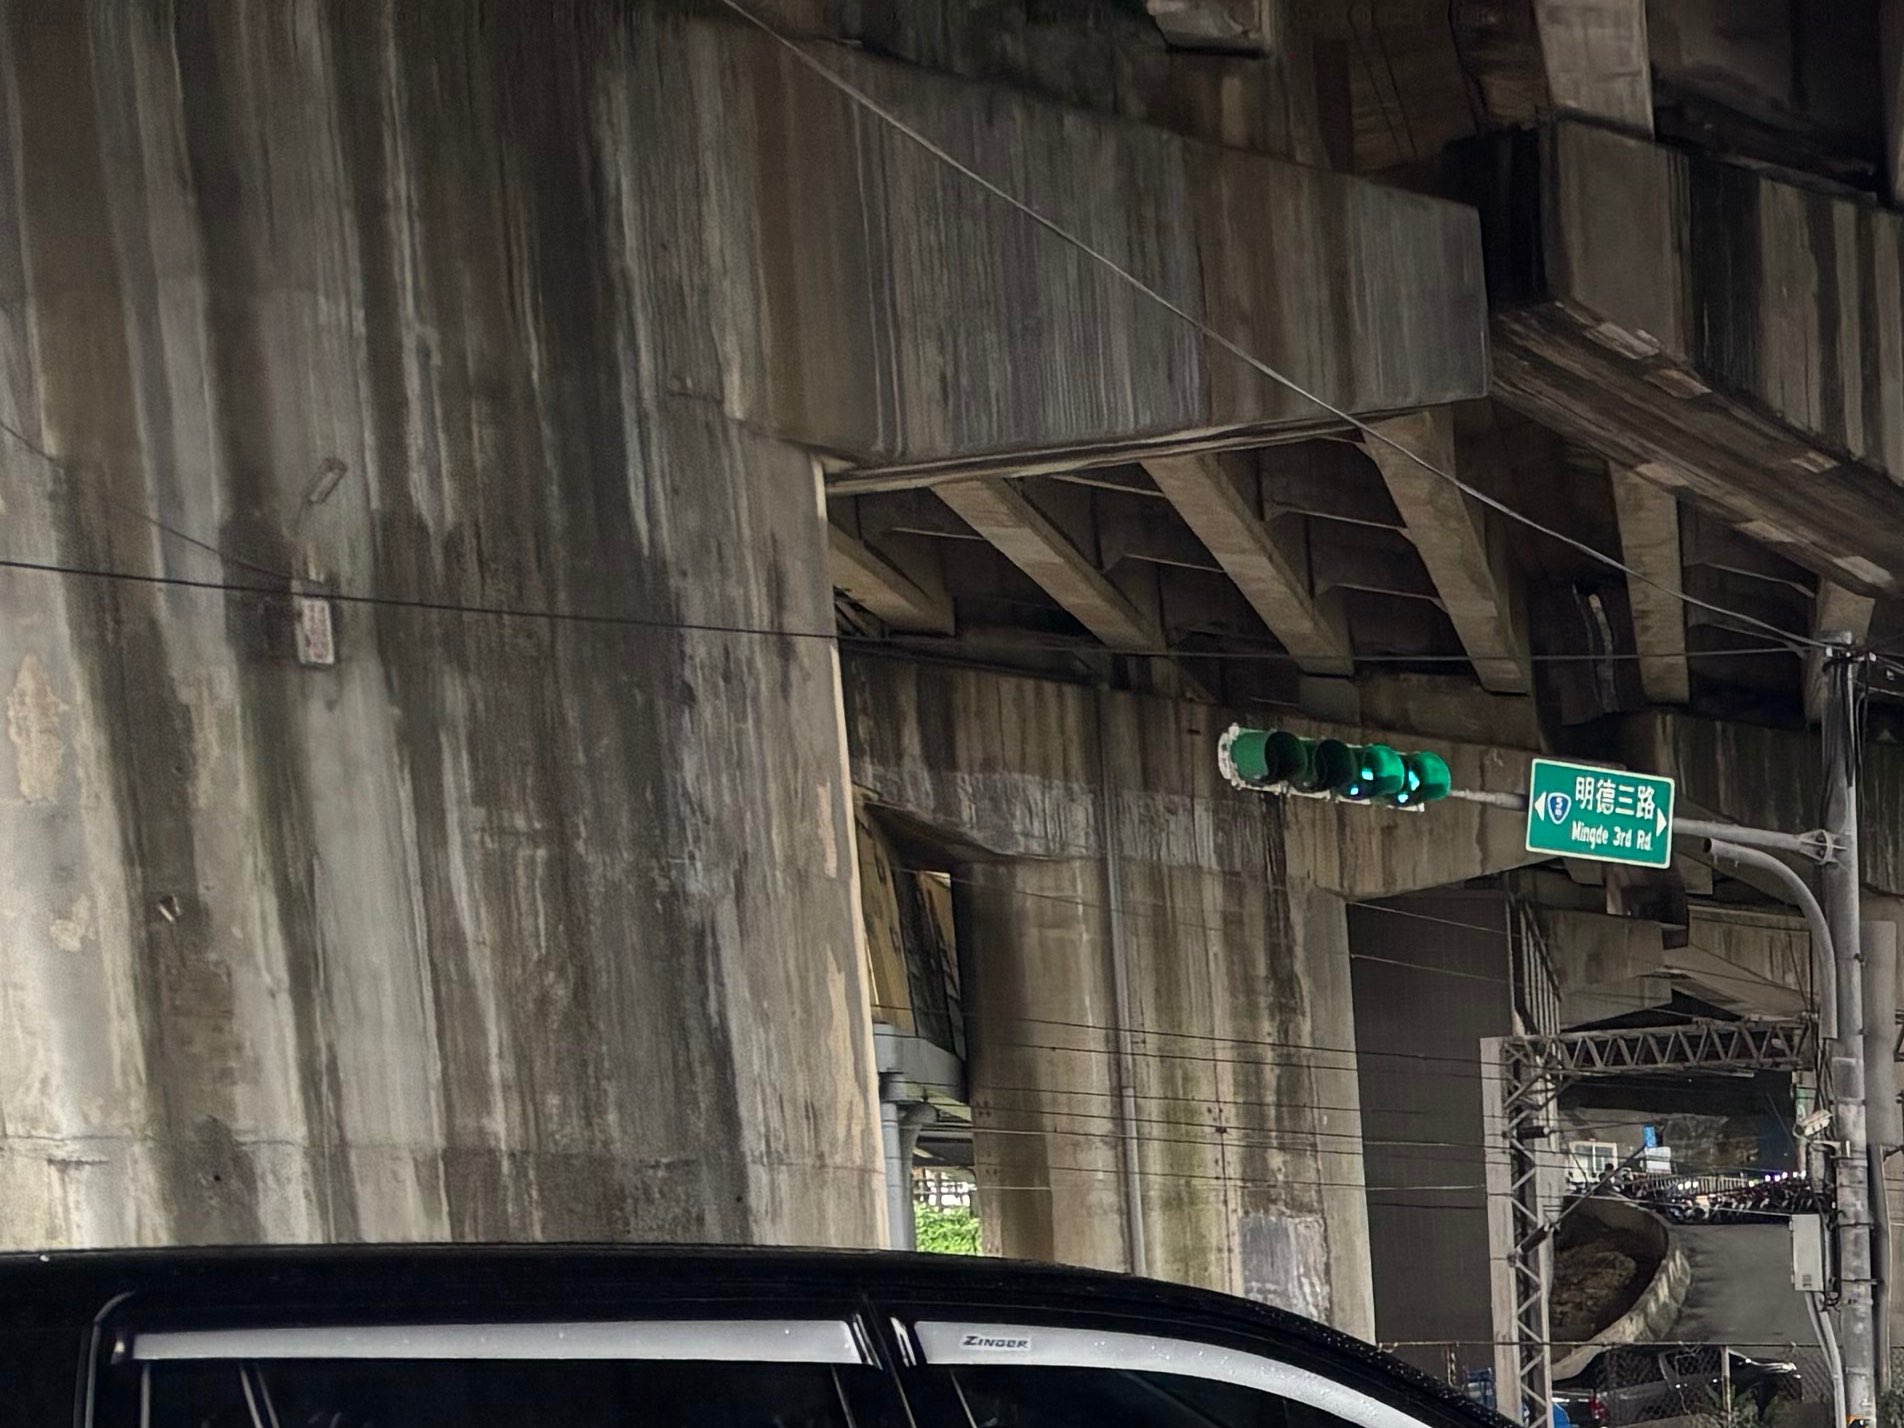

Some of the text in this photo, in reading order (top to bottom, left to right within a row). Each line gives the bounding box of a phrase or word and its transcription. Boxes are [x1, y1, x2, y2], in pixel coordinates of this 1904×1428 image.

[1575, 776, 1655, 820] 明德三路
[1571, 821, 1608, 849] Mingde
[1612, 826, 1632, 848] 3rd
